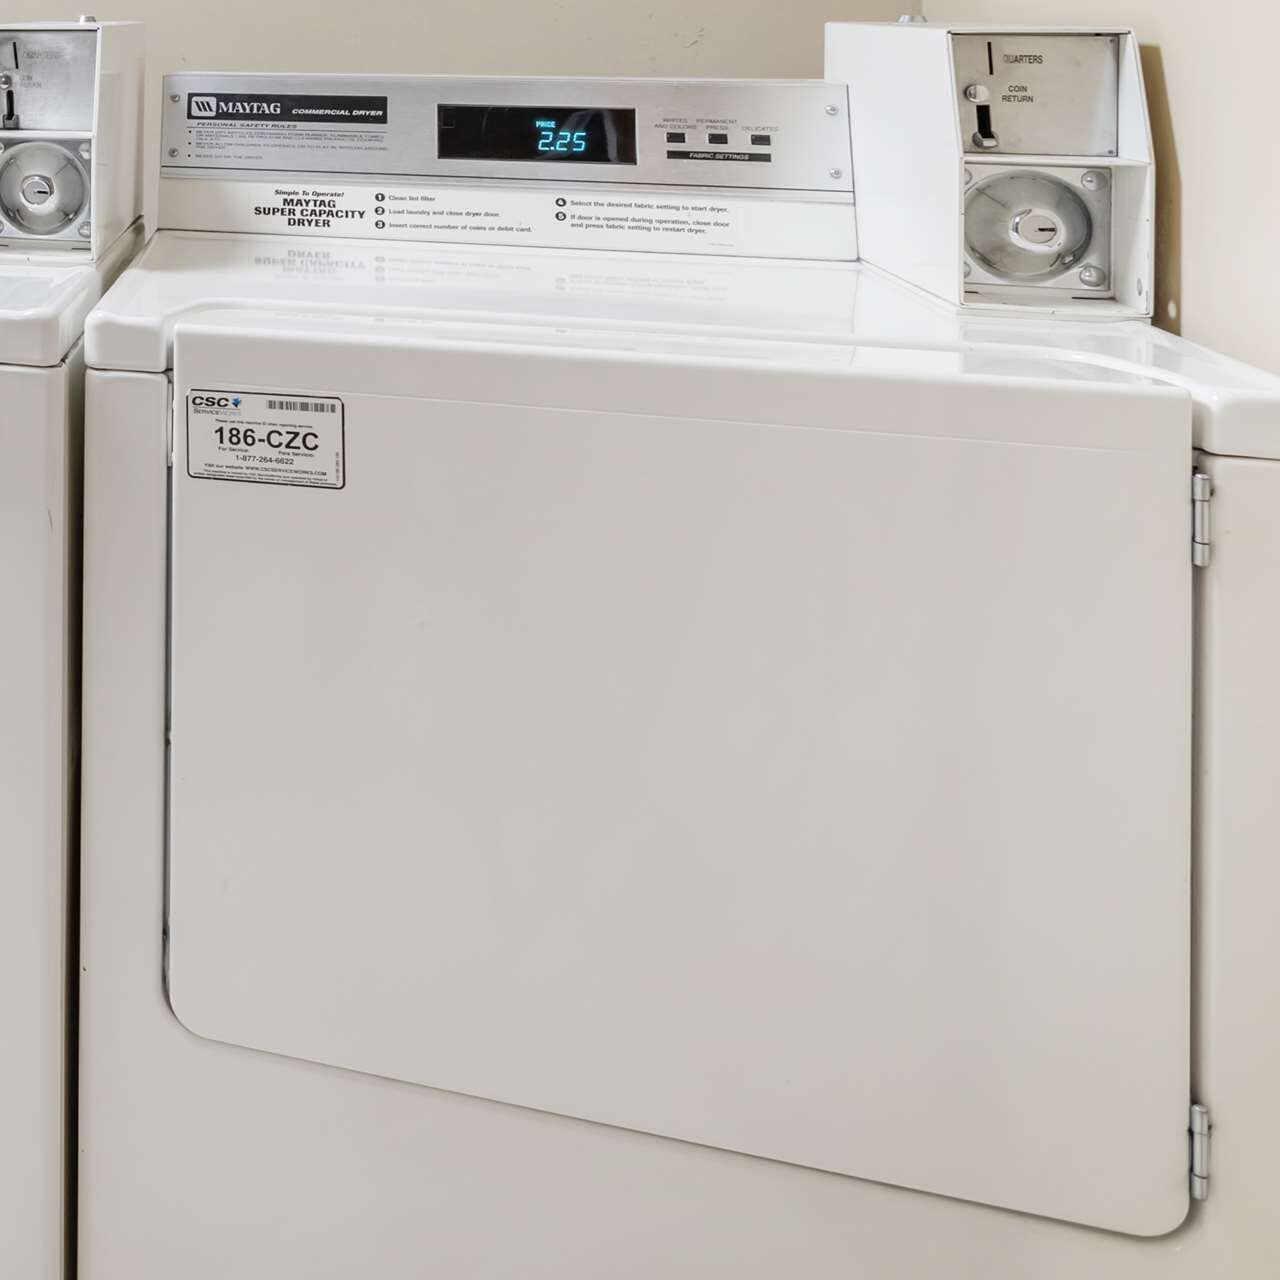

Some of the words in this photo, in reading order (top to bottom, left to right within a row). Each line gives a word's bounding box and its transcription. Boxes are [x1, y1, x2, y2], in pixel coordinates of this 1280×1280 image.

[1003, 54, 1043, 64] QUARTERS
[218, 101, 281, 115] MAYTAG
[291, 108, 350, 116] COMMERCIAL
[352, 109, 384, 117] DRYER
[538, 131, 586, 152] 2.25
[282, 198, 336, 208] MAYTAG
[254, 206, 296, 216] SUPER
[300, 208, 366, 219] CAPACITY
[287, 218, 331, 227] DRYER
[192, 396, 229, 408] CSC
[214, 426, 319, 451] 186-CZC
[236, 454, 295, 465] 1-877-264-6622
